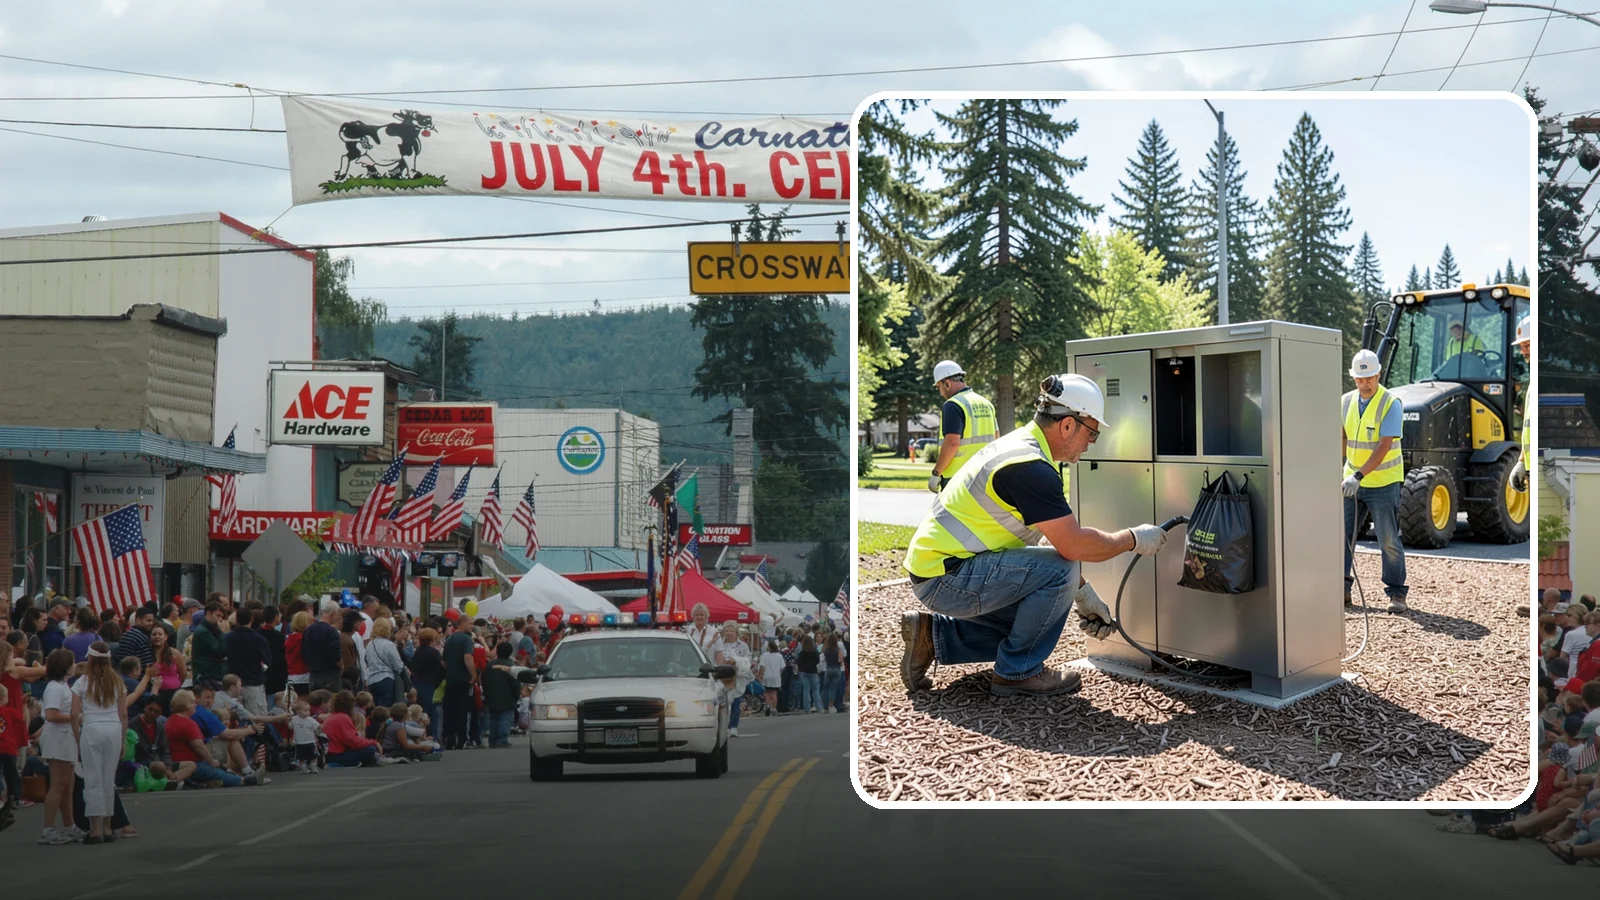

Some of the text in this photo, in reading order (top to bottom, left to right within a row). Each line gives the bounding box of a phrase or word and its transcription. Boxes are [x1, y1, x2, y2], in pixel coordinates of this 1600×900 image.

[482, 141, 605, 192] JULY
[632, 150, 746, 197] 4th.
[697, 254, 850, 280] CROSSWA
[283, 380, 373, 420] ACE
[406, 409, 485, 422] CEDAR LOG
[283, 421, 371, 436] Hardware
[416, 428, 477, 447] Coca-Cola
[83, 484, 155, 495] St. Vincent de Paul
[688, 526, 741, 535] CRNATION
[699, 535, 730, 543] GLASS
